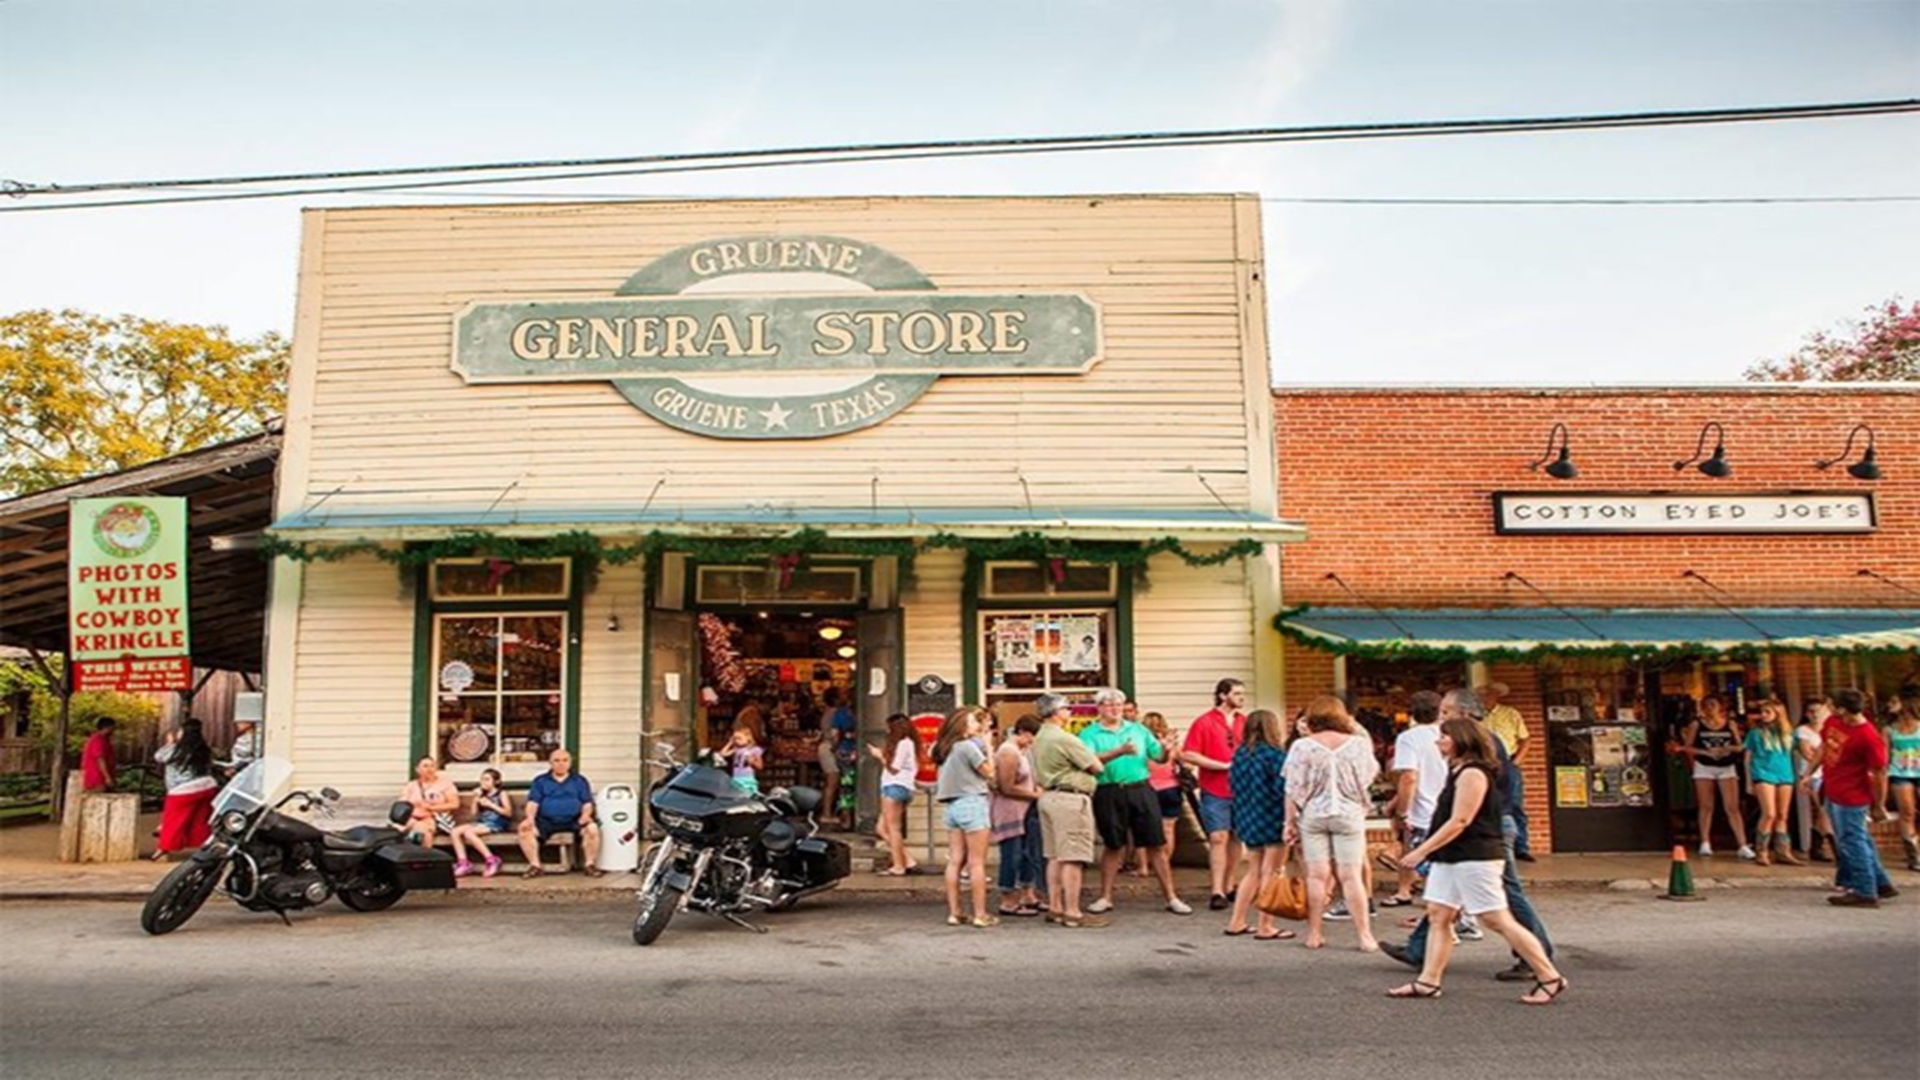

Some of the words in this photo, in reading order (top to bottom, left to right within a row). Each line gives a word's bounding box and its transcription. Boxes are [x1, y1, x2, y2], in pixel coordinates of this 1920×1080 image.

[690, 241, 863, 275] GRUENE
[510, 313, 781, 361] GENERAL
[811, 309, 1029, 356] STORE
[653, 386, 748, 430] GRUENE
[810, 382, 896, 428] TEXAS
[1513, 504, 1637, 520] COTTON
[1665, 504, 1746, 520] EYED
[1774, 503, 1861, 519] JOE'S
[78, 562, 178, 583] PHOTOS
[94, 586, 162, 605] WITH
[76, 608, 180, 629] COWBOY
[75, 631, 184, 651] KRINGLE
[81, 662, 125, 674] THIS
[131, 660, 182, 672] WEEK
